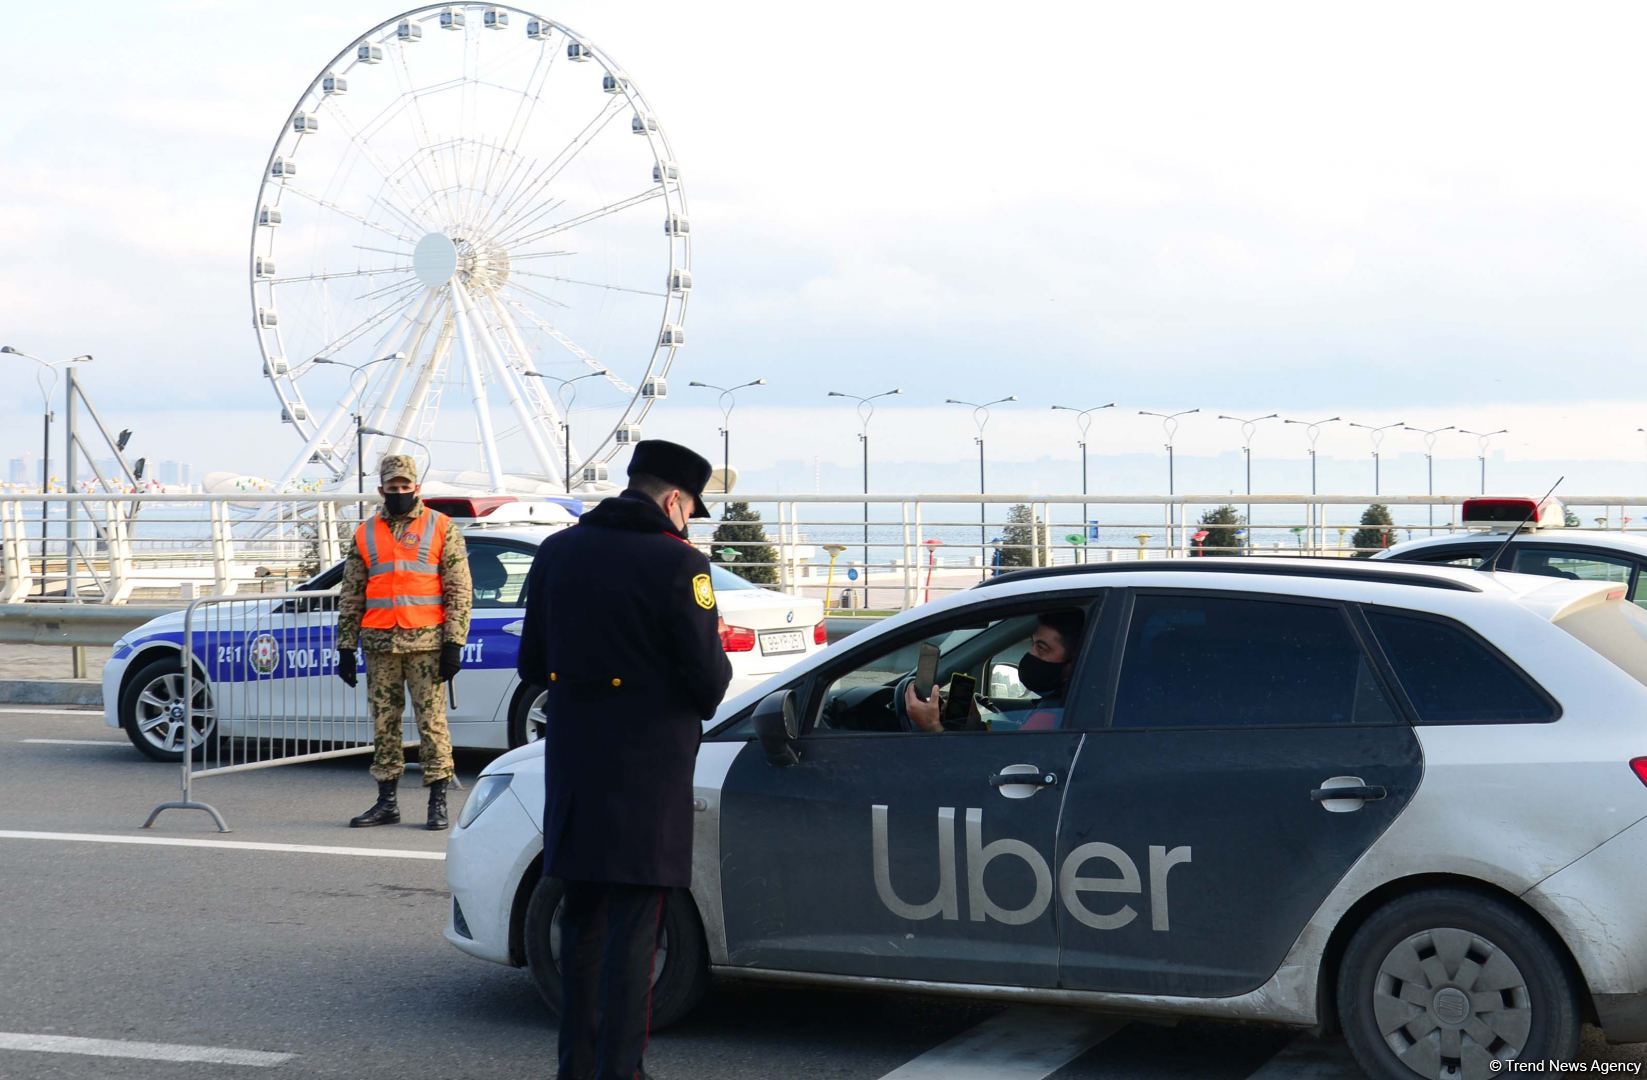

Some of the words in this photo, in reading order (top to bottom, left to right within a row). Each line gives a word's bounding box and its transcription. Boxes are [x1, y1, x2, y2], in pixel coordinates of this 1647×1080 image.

[217, 646, 242, 663] 251
[286, 648, 318, 669] YOL
[871, 804, 1192, 931] Uber
